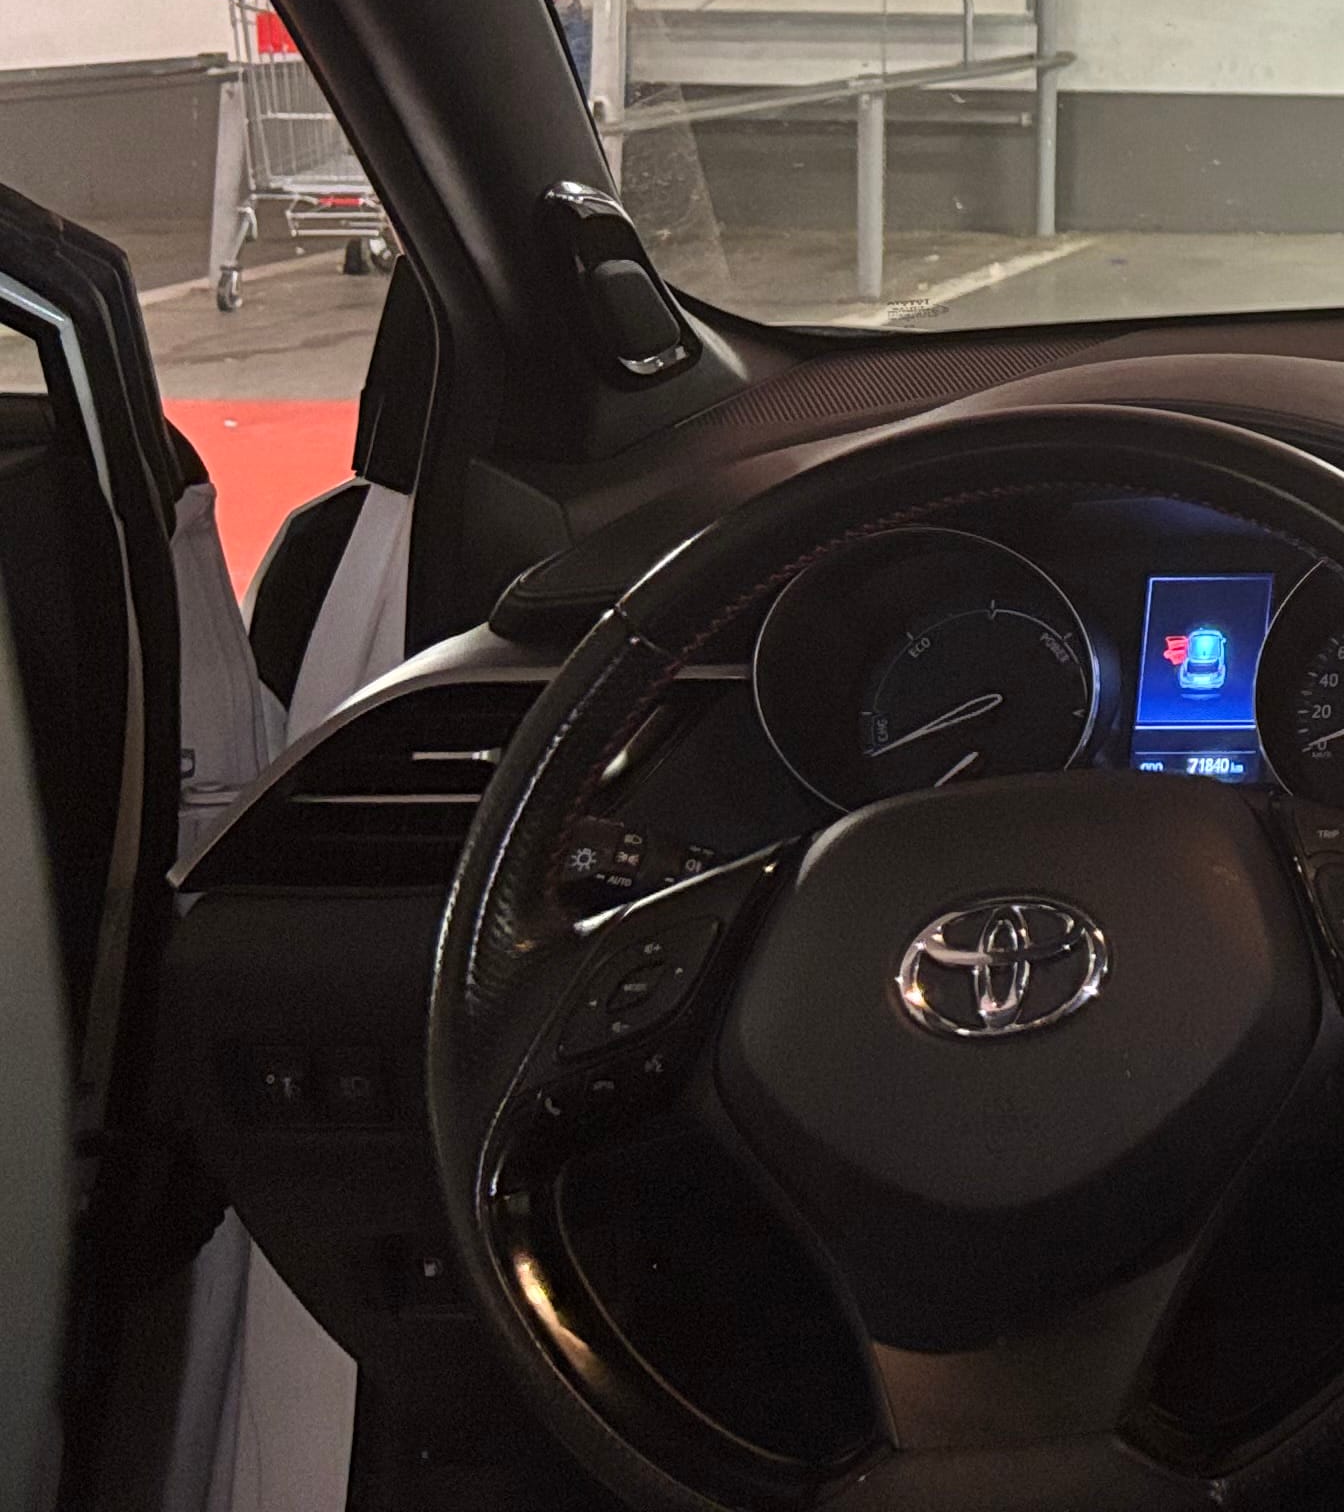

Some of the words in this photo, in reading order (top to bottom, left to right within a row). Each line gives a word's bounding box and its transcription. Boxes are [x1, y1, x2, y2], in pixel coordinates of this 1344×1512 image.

[1319, 673, 1339, 688] 40
[1311, 704, 1332, 719] 20
[1186, 757, 1230, 774] 71840
